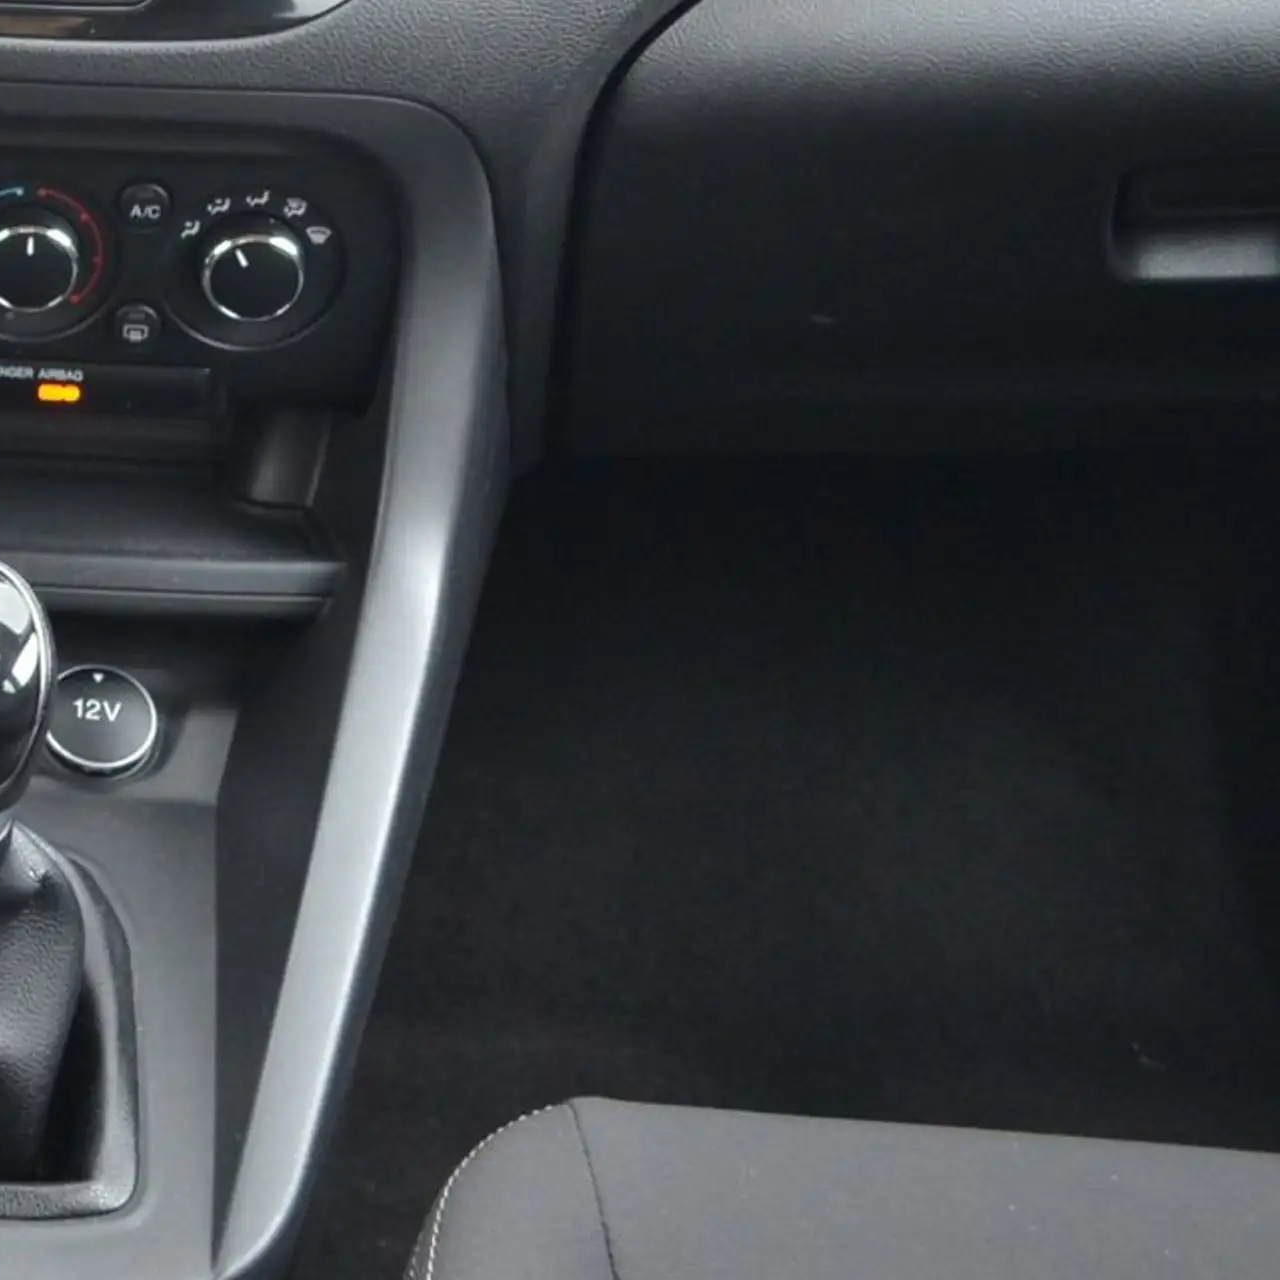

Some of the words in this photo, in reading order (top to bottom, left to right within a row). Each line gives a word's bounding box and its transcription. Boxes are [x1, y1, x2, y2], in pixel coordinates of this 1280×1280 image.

[130, 204, 161, 220] A/C
[37, 367, 84, 382] AIRBAG
[73, 698, 123, 722] 12V
